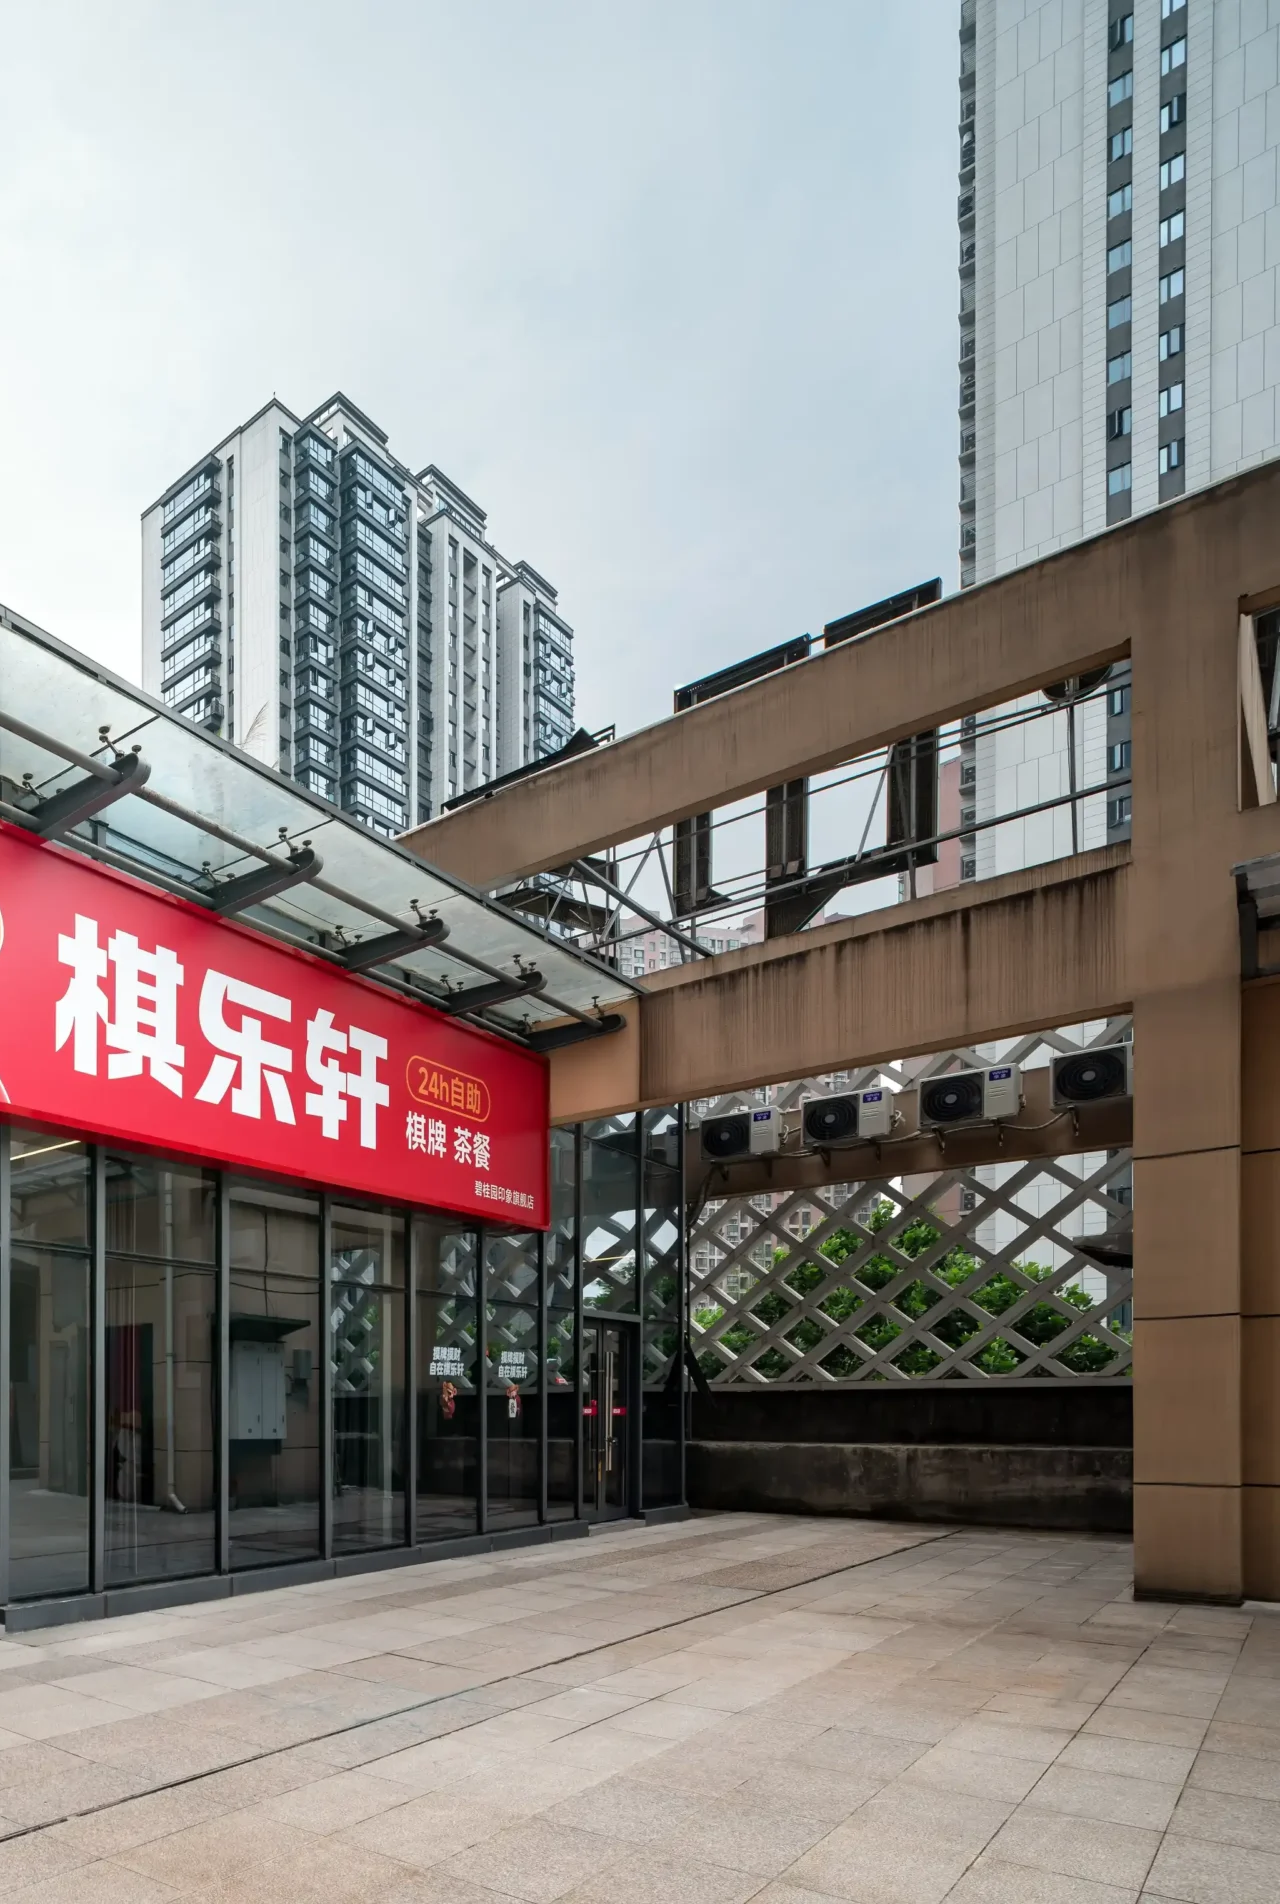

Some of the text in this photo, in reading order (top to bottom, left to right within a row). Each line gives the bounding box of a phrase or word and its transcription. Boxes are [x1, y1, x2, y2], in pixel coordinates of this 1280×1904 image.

[55, 913, 390, 1150] 棋乐轩
[418, 1066, 481, 1114] 24h自助
[406, 1110, 490, 1171] 棋牌 茶餐
[474, 1180, 534, 1210] 碧桂园印象旗舰店
[429, 1362, 465, 1376] 自在棋乐轩
